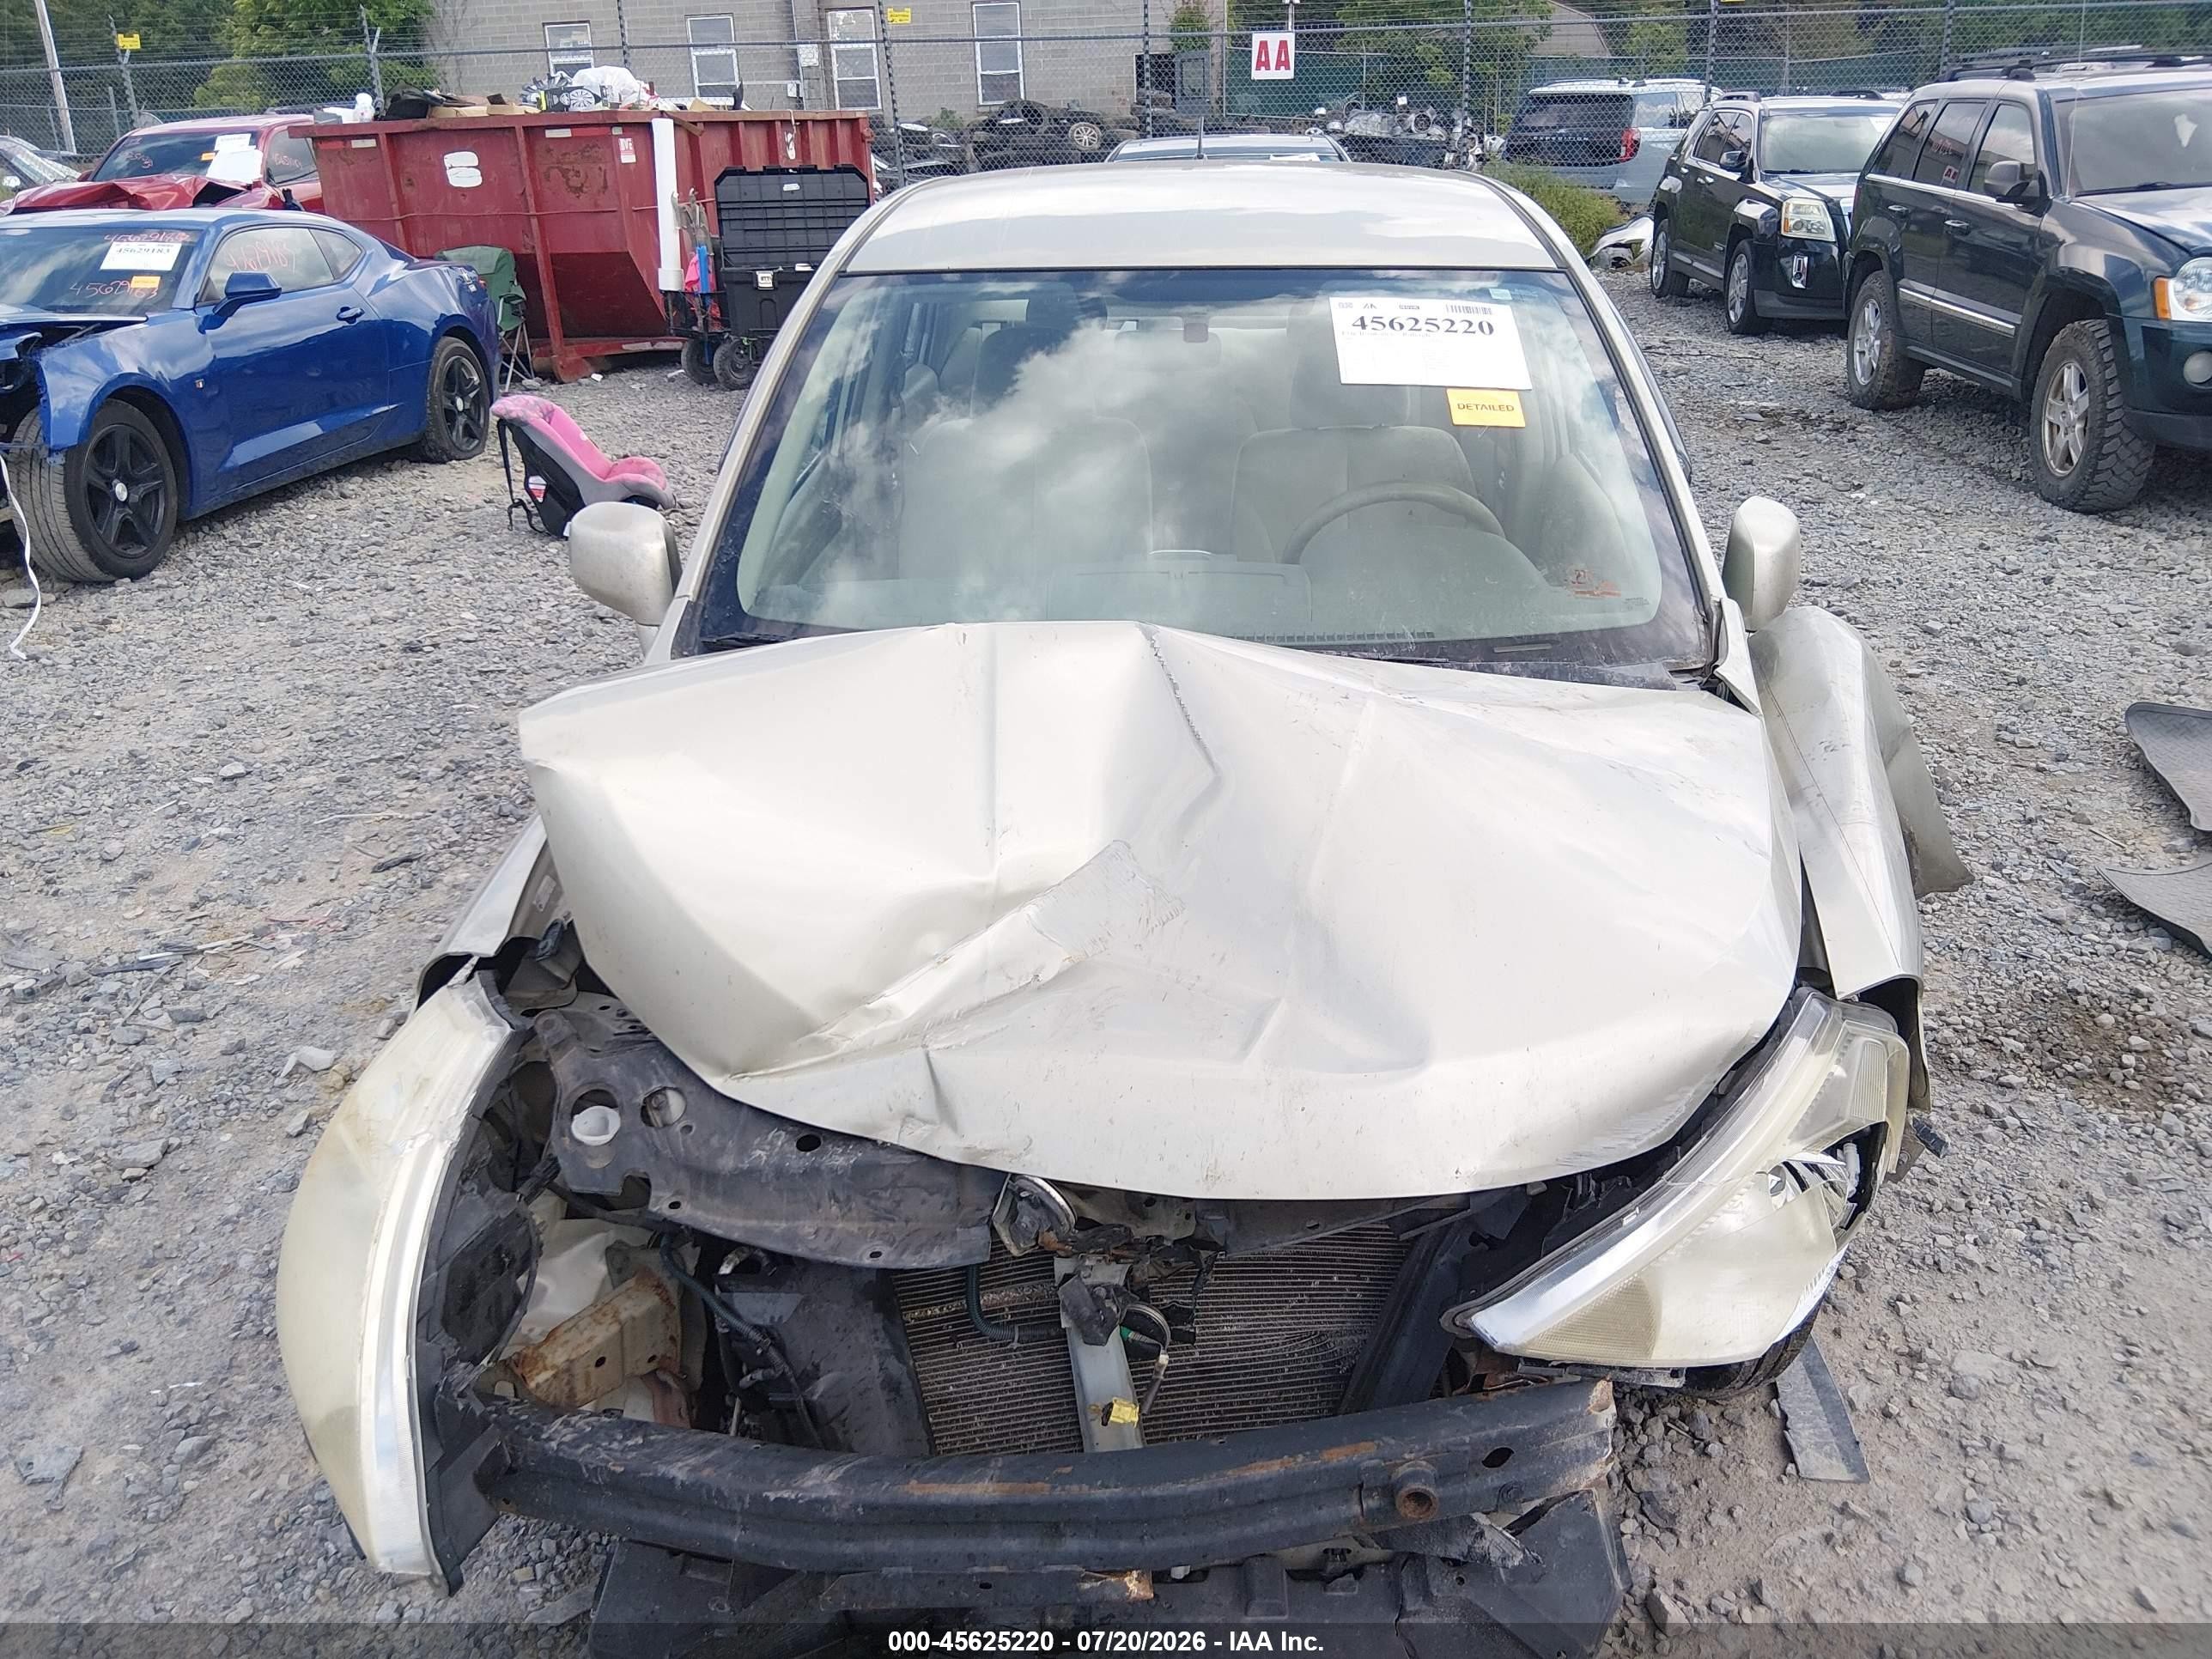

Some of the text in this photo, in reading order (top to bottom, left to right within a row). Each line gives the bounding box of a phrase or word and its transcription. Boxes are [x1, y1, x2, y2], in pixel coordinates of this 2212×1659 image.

[1255, 40, 1291, 71] AA
[1351, 315, 1495, 337] 45625220
[1456, 402, 1515, 412] DETAILED
